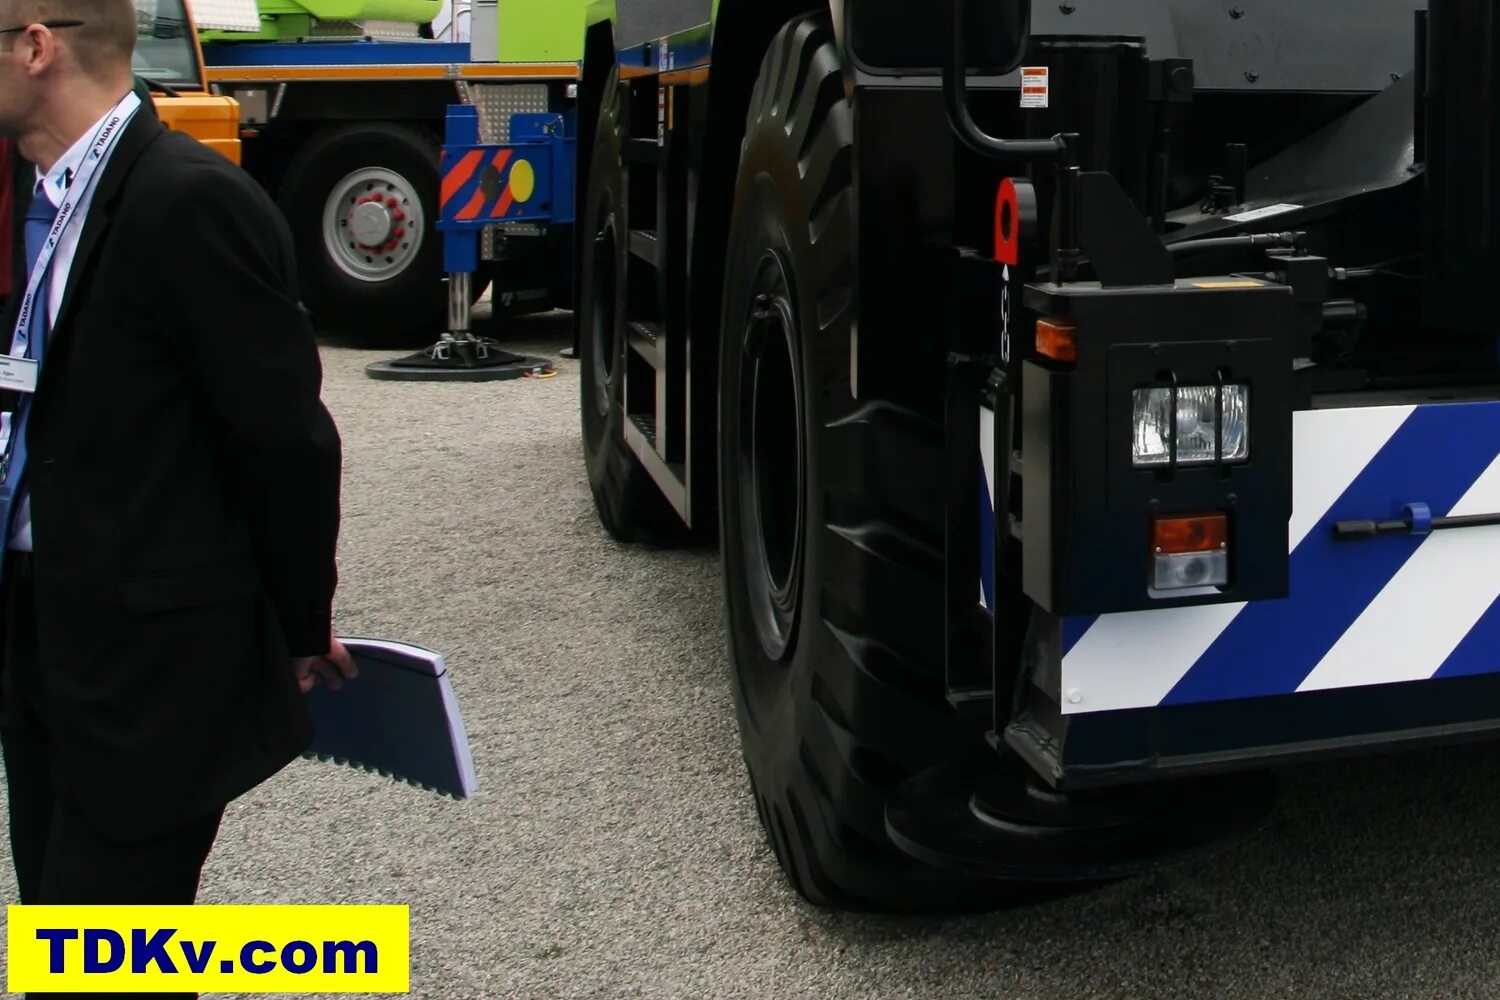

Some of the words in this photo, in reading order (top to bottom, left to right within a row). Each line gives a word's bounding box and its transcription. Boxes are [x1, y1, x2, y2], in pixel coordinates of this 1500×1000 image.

[96, 116, 120, 147] TADANO
[52, 202, 71, 237] TADANO
[19, 293, 32, 328] TADANO
